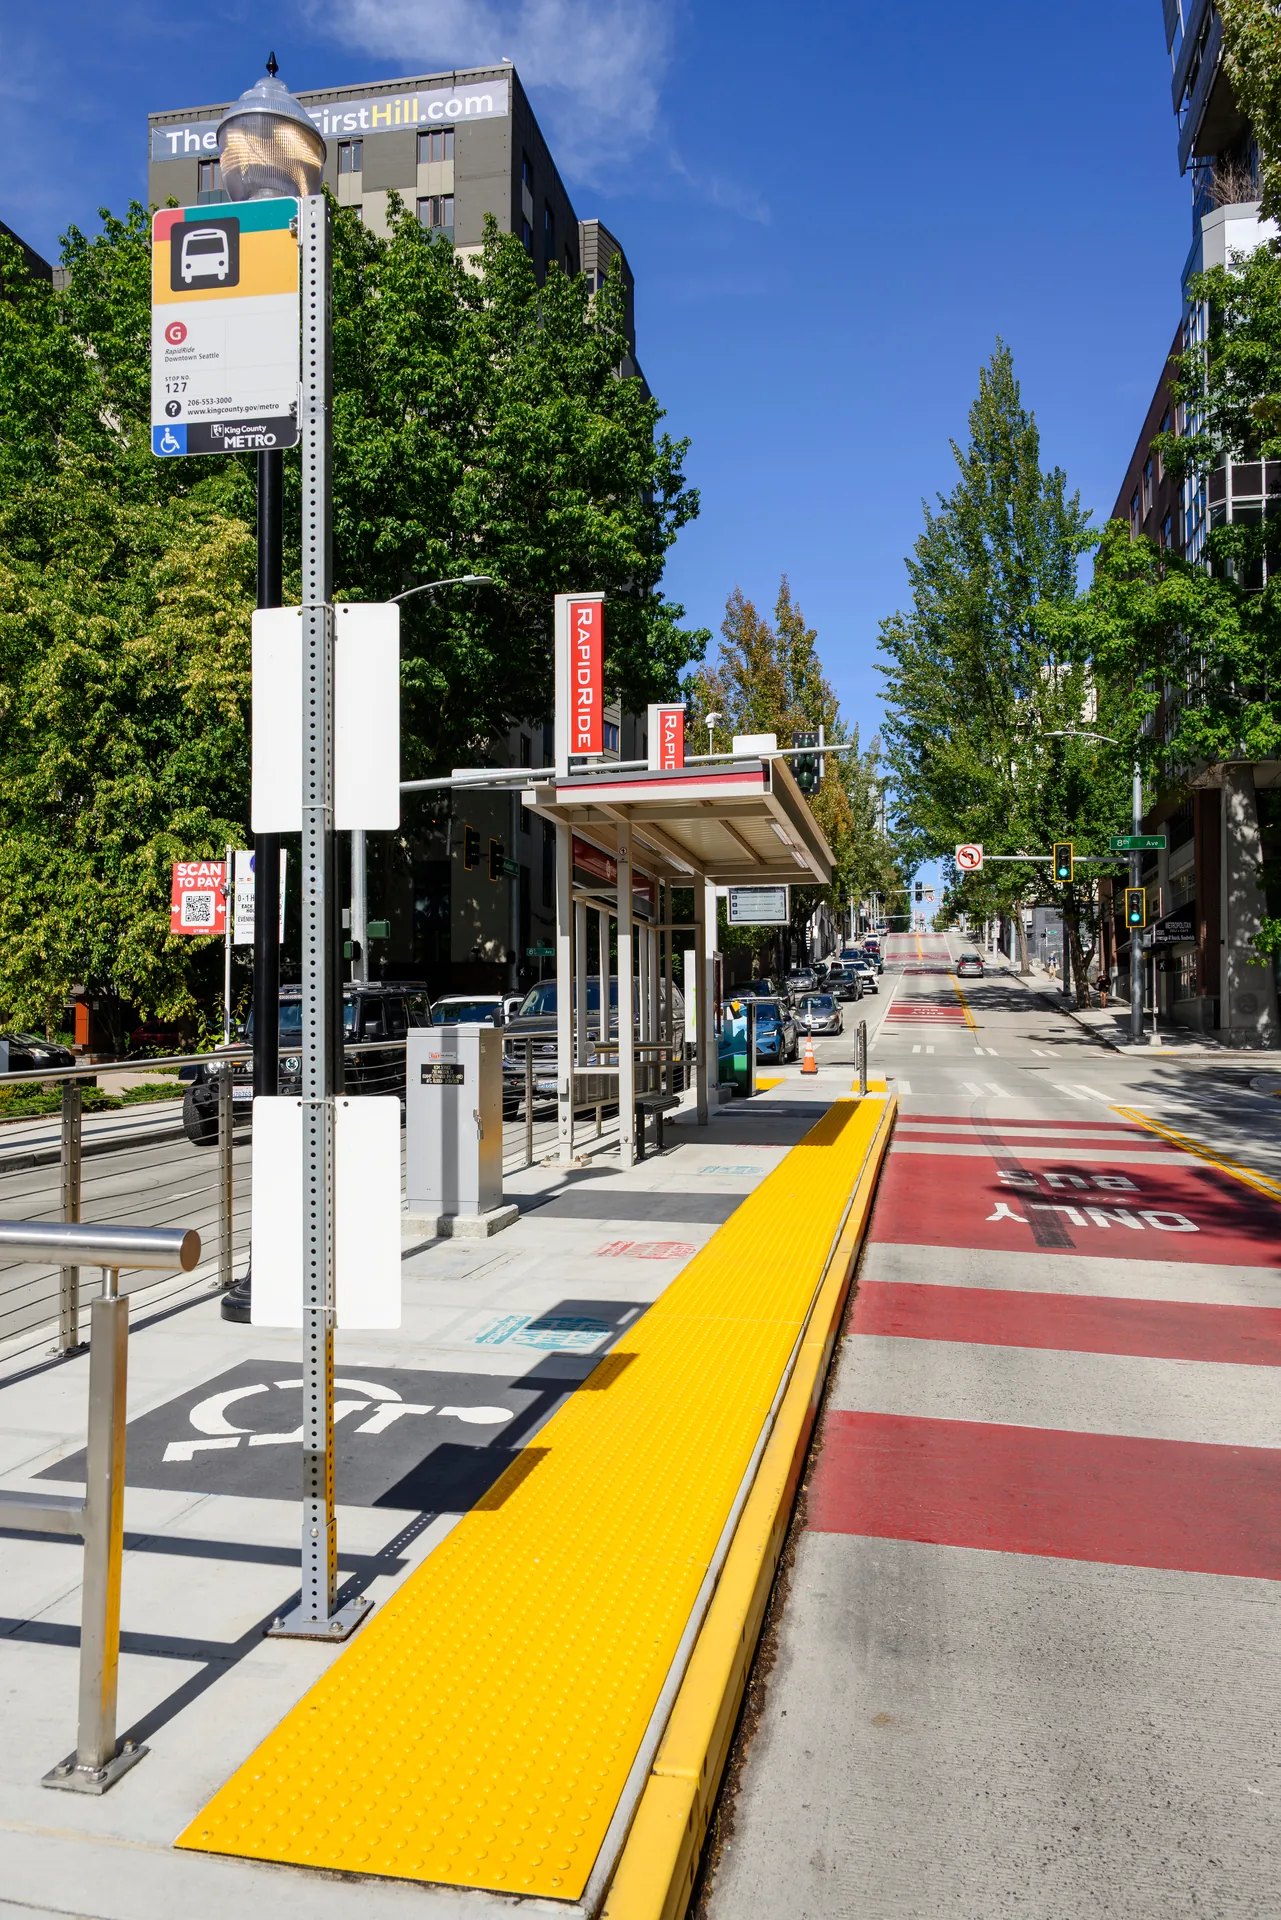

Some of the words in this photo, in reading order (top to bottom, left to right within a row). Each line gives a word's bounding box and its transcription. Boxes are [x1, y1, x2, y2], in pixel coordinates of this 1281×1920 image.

[166, 129, 217, 154] The
[170, 326, 182, 341] G
[164, 354, 198, 362] Downtown
[198, 352, 220, 360] Seattle
[165, 346, 196, 355] RapidRide
[166, 382, 188, 394] 127
[188, 396, 232, 406] 206-553-3000
[188, 402, 280, 416] www.kingcounty.gov/metro
[224, 426, 241, 435] King
[241, 424, 267, 434] County
[224, 434, 276, 448] METRO
[578, 608, 592, 748] RAPIDRIDE
[177, 864, 222, 876] SCAN
[177, 878, 195, 888] TO
[197, 877, 222, 888] PAY
[996, 1170, 1141, 1192] BUS
[986, 1202, 1200, 1232] ONLY
